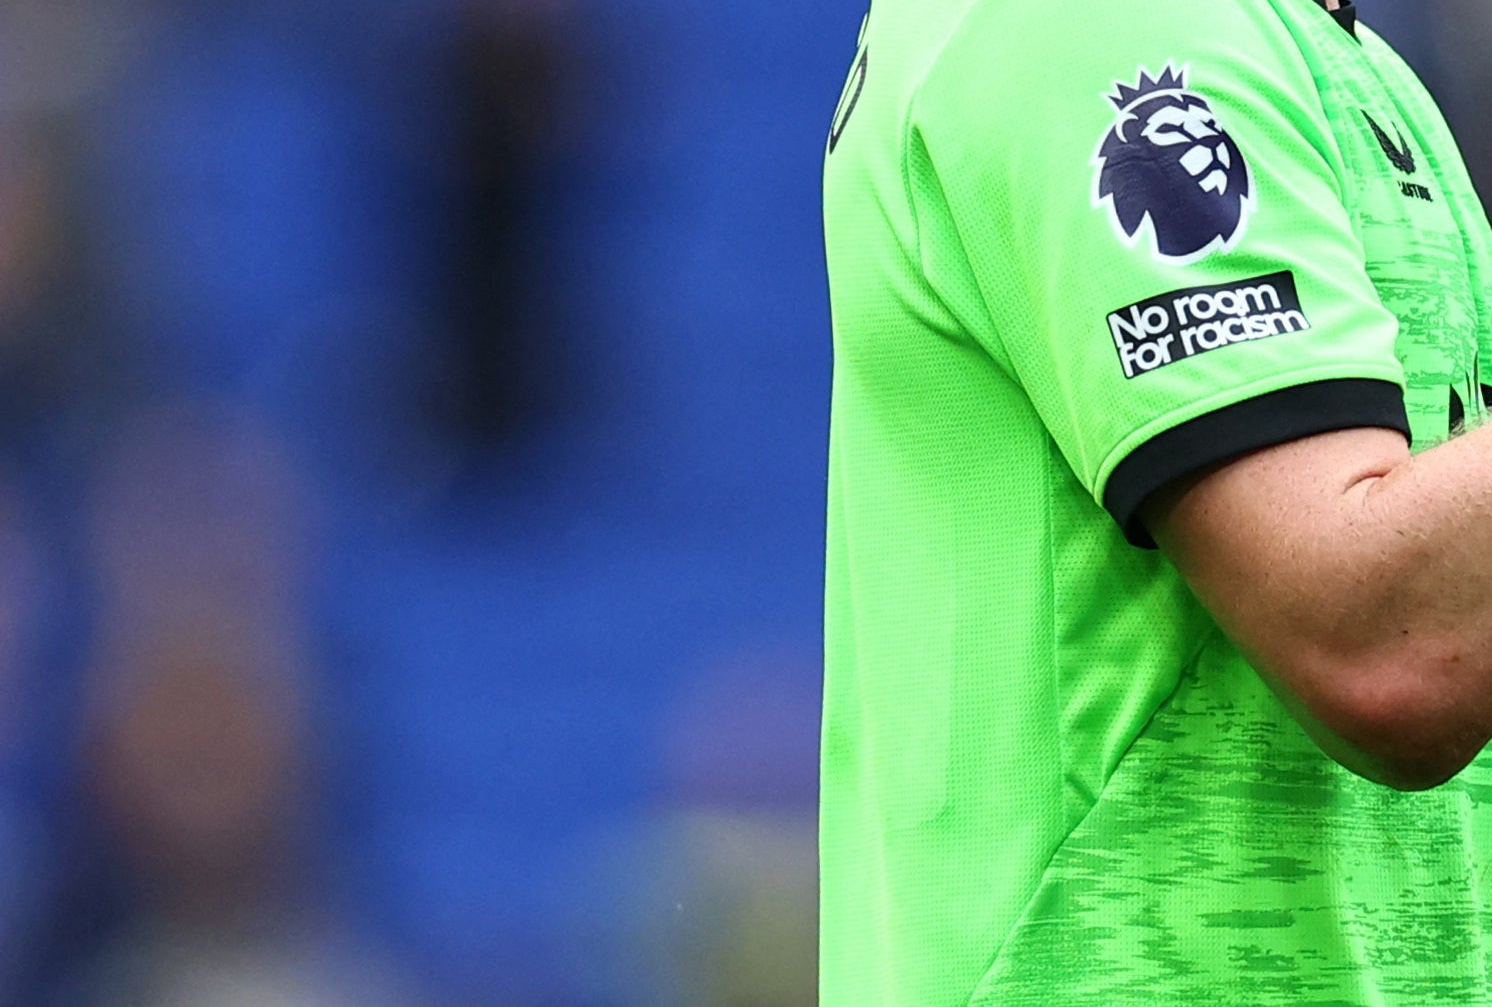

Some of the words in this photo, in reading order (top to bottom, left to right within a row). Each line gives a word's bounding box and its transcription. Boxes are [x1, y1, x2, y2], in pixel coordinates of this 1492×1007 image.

[1108, 305, 1169, 348] No
[1174, 284, 1281, 326] room
[1119, 336, 1174, 378] for
[1181, 309, 1311, 355] racism
